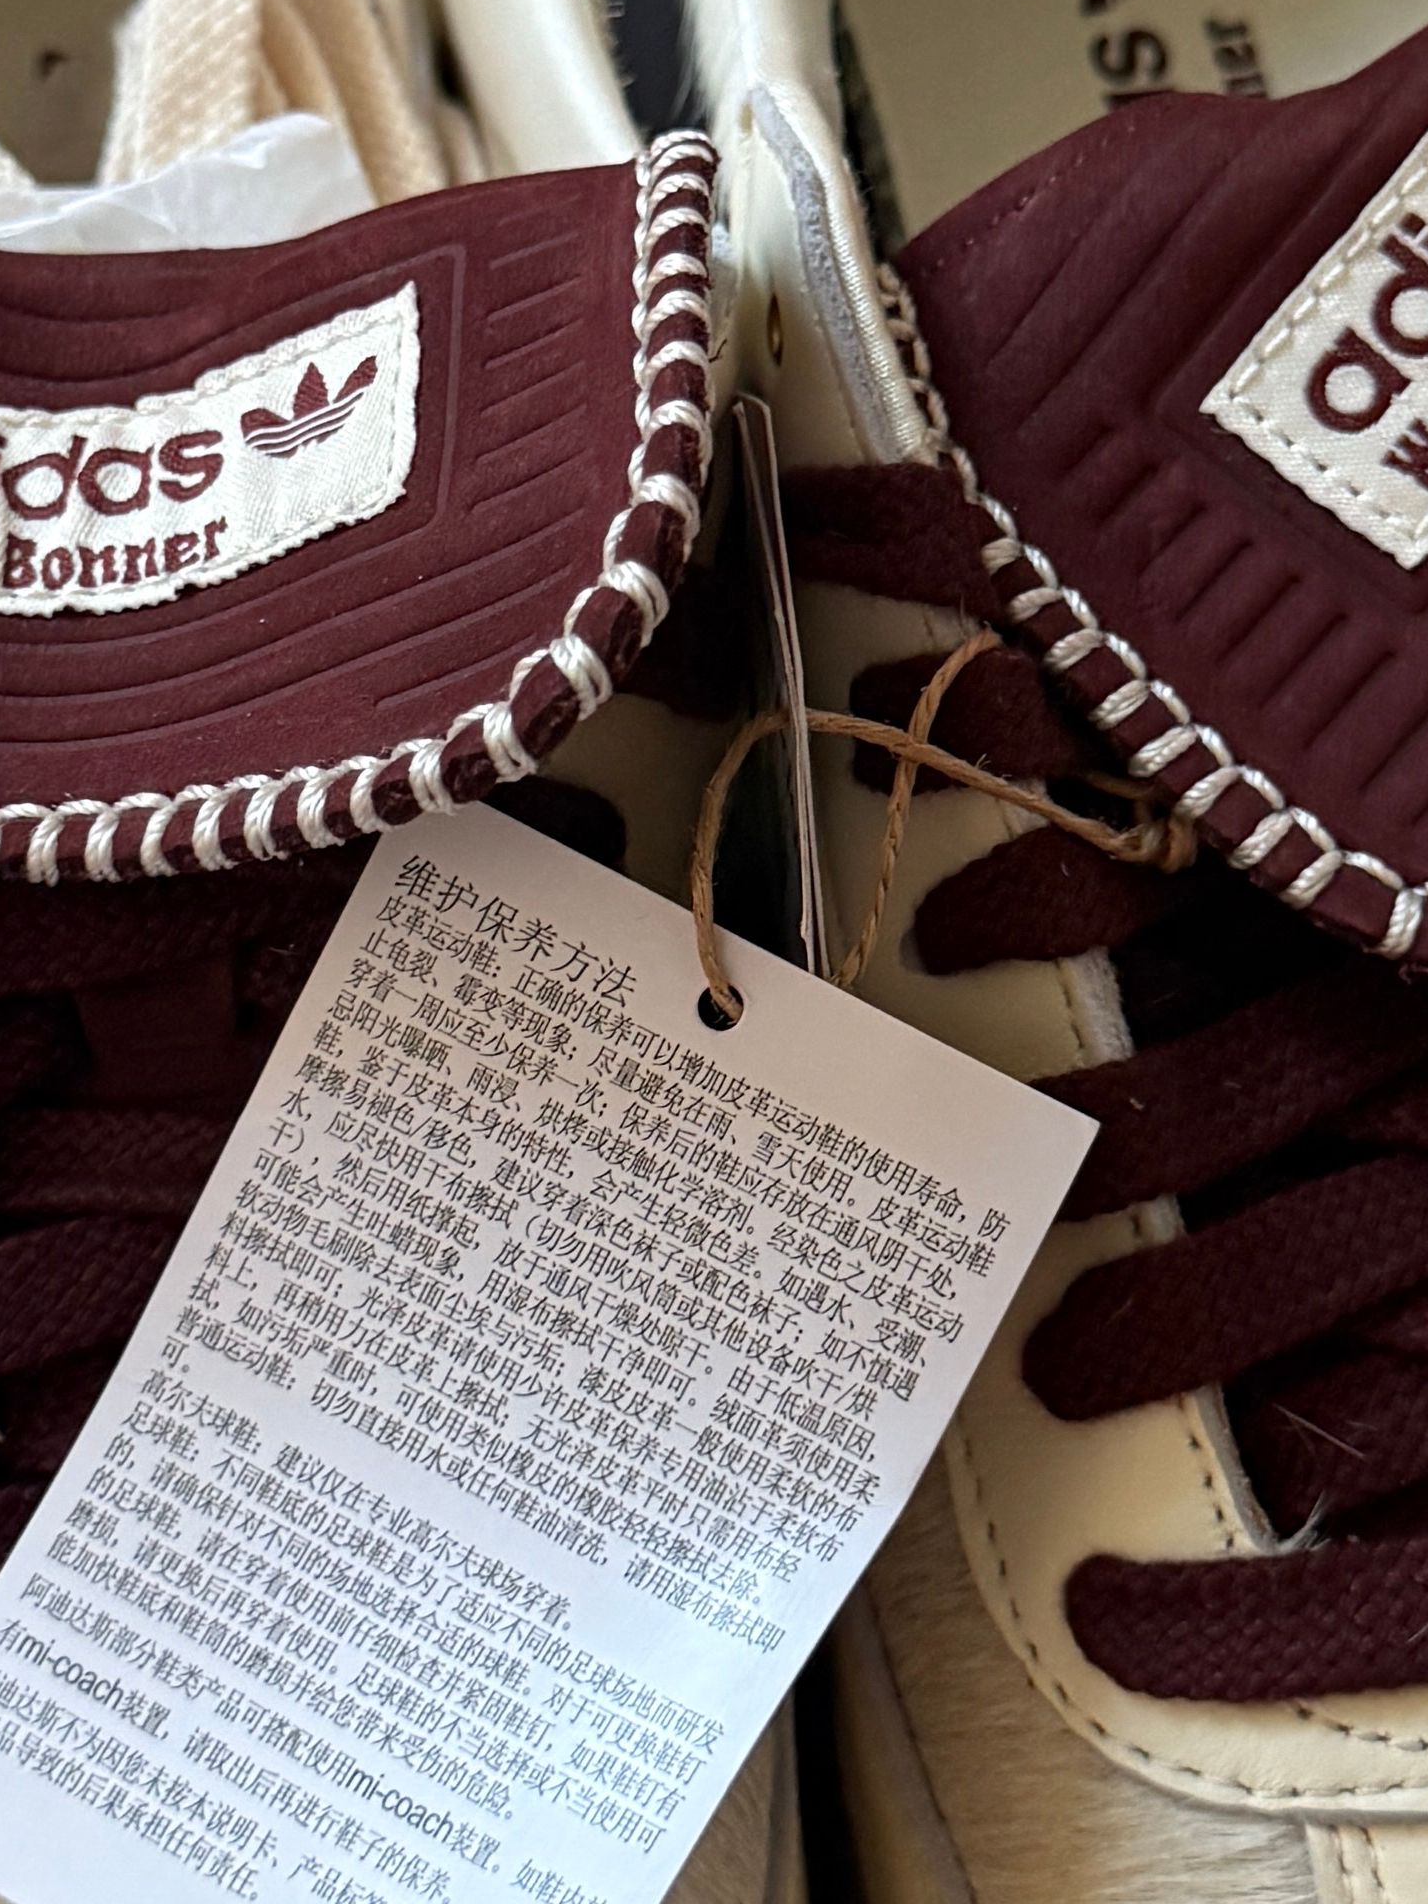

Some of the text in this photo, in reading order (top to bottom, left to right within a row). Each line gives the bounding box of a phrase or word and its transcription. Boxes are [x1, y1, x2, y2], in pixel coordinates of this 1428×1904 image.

[0, 515, 230, 592] Bonner
[392, 853, 638, 1009] 维护保养方法
[160, 1335, 191, 1374] 可。
